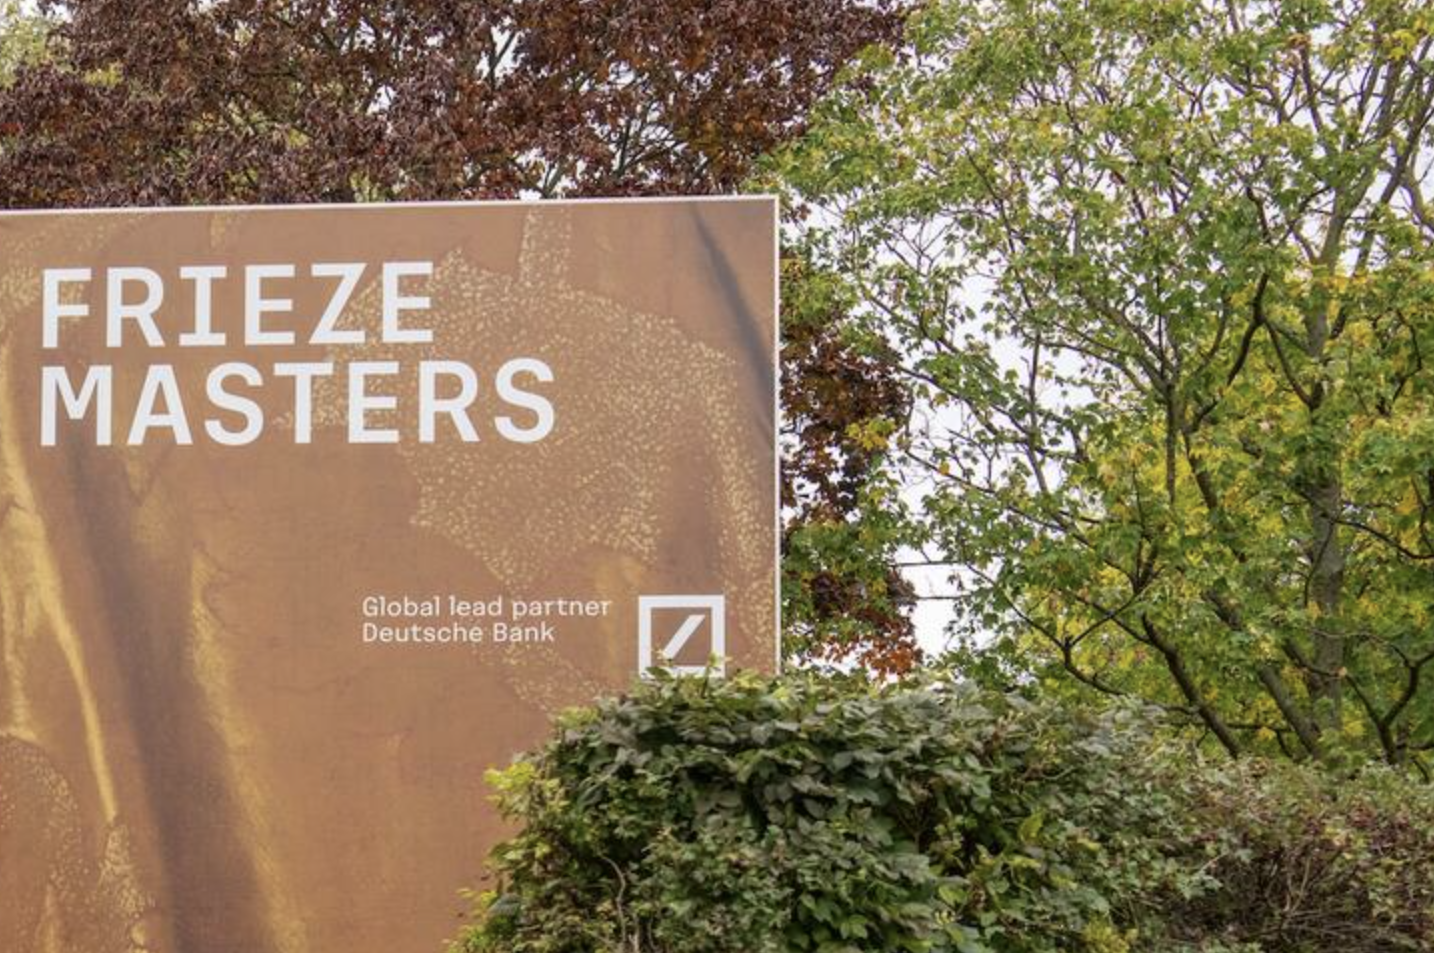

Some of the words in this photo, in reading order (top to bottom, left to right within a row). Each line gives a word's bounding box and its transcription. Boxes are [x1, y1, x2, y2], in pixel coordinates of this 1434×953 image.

[41, 260, 435, 349] FRIEZE
[40, 357, 557, 447] MASTERS
[362, 594, 441, 618] Global
[448, 594, 504, 618] lead
[511, 598, 612, 621] partner
[362, 622, 484, 643] Deutsche
[492, 621, 556, 643] Bank
